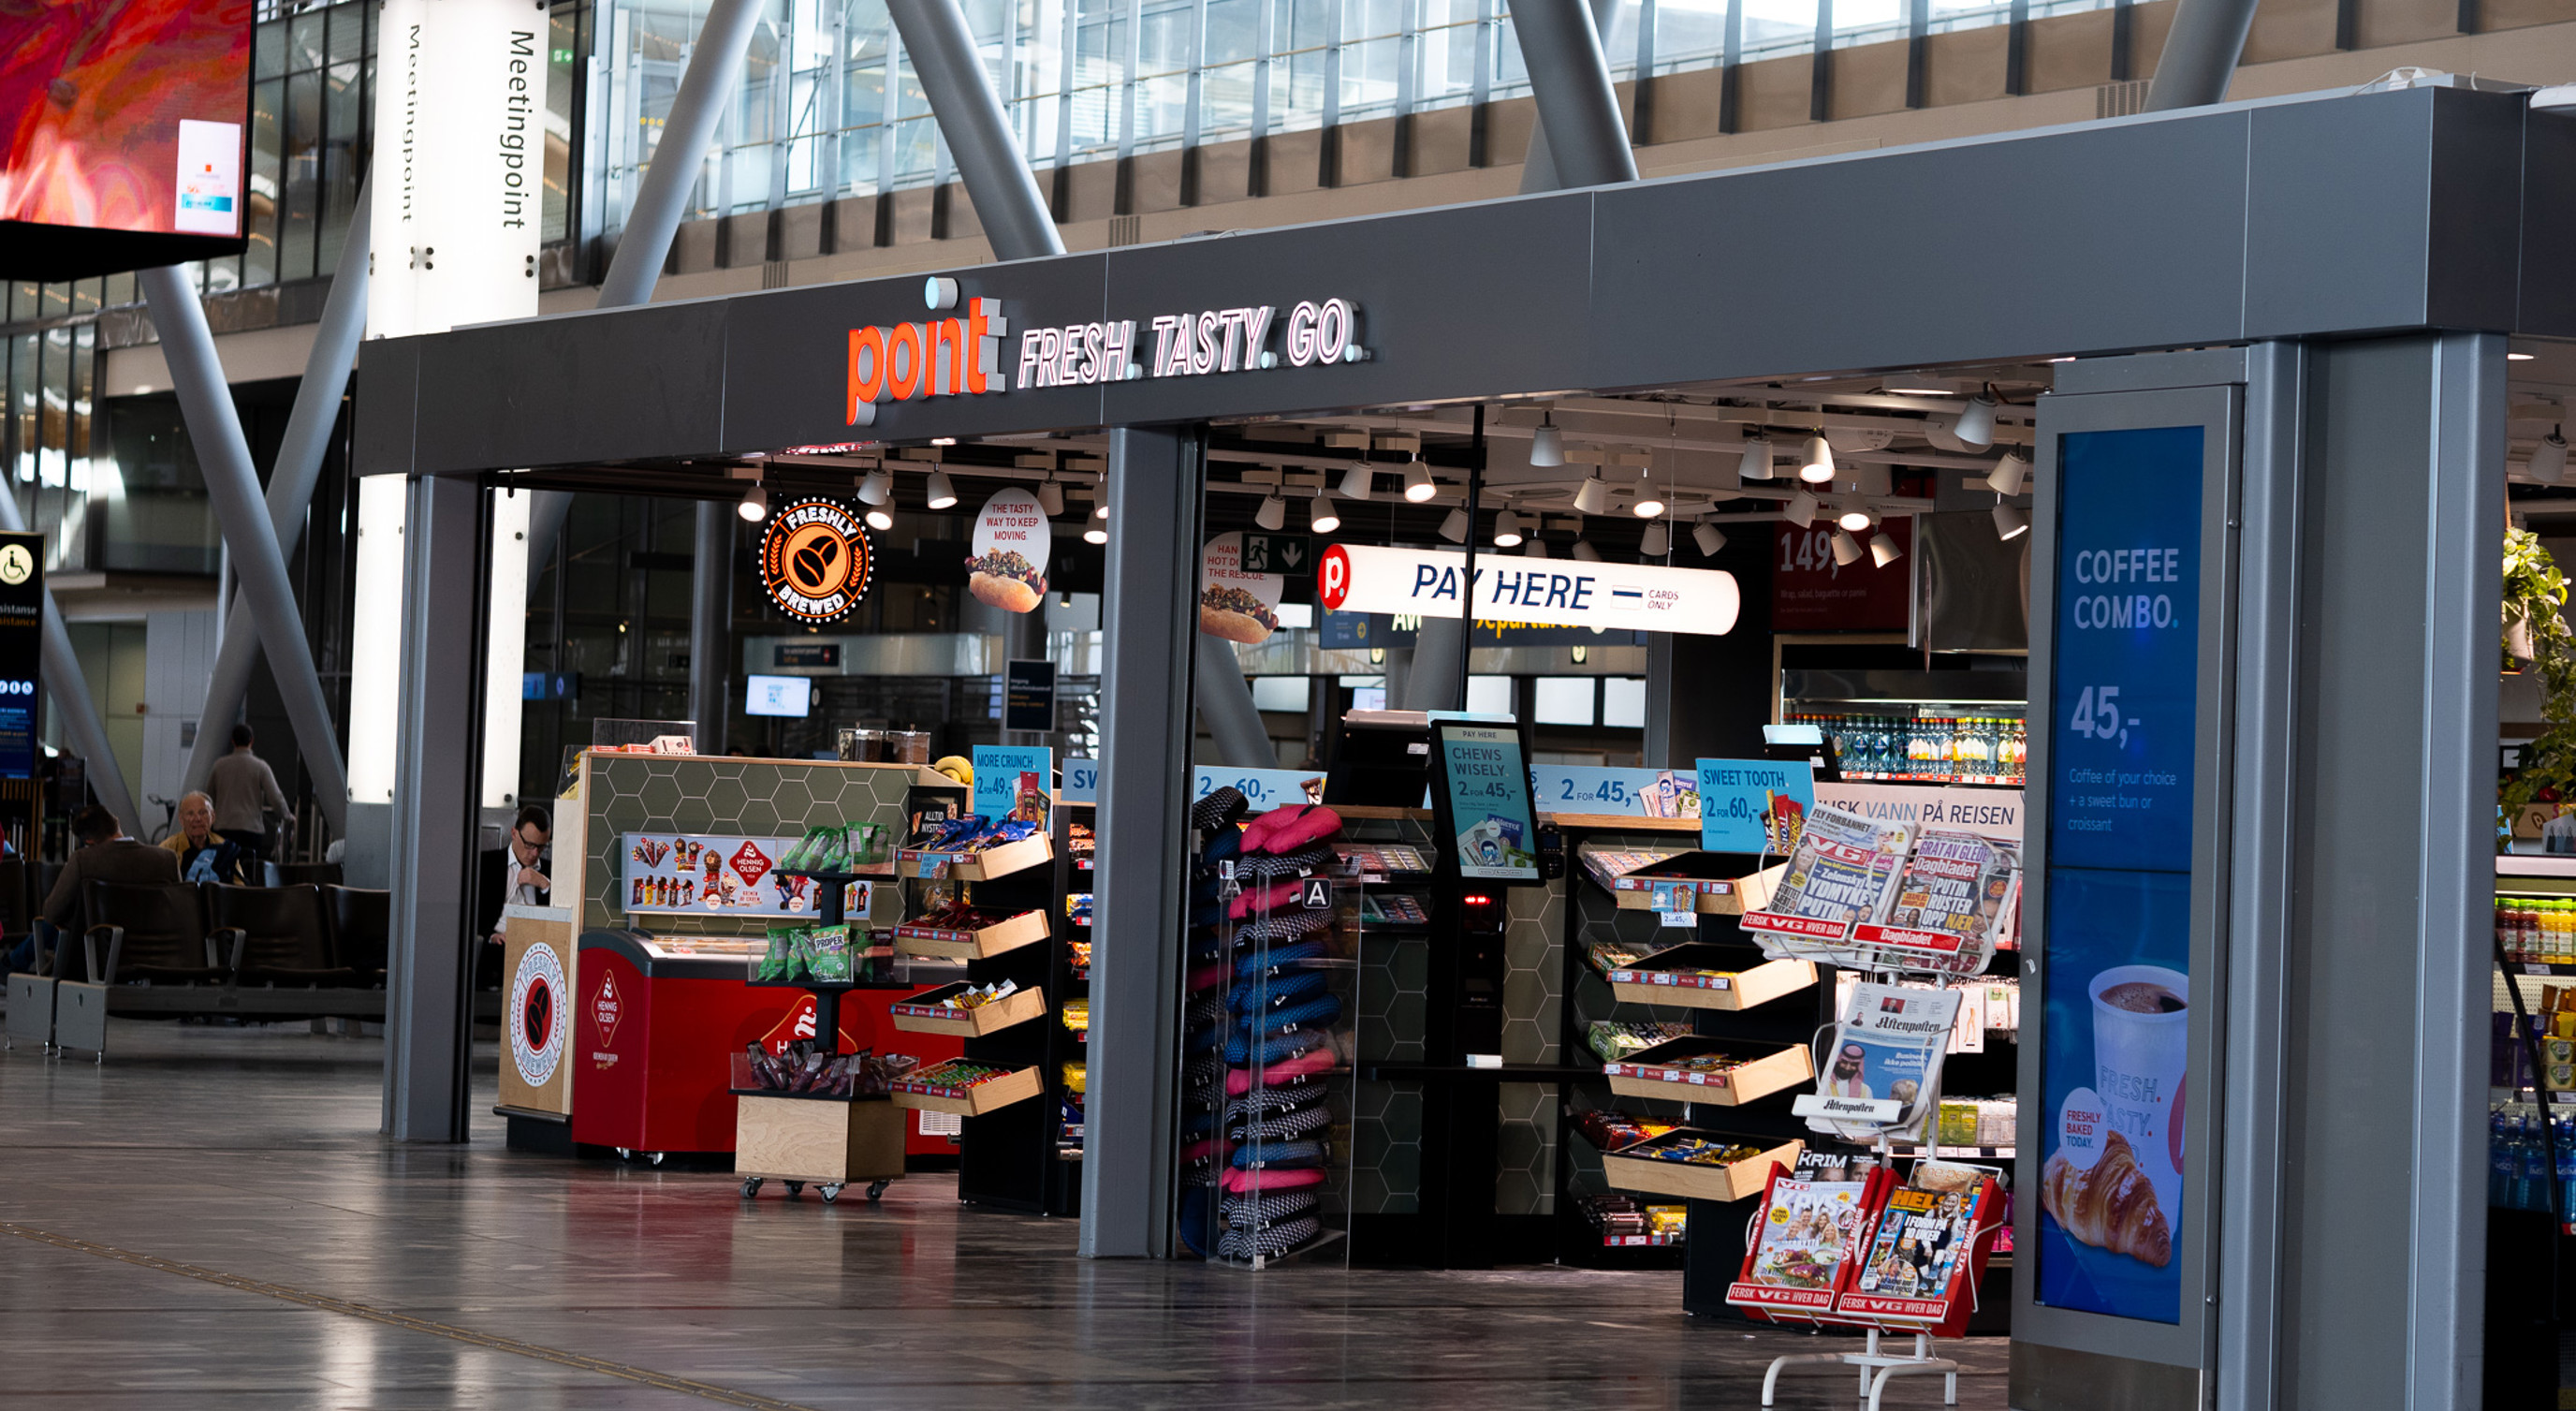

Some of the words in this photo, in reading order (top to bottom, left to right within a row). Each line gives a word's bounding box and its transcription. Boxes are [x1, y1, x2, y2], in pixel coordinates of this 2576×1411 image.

[402, 24, 420, 223] Meetingpoint
[500, 30, 534, 229] Meetingpoint
[846, 276, 998, 426] point
[1017, 319, 1143, 389] FRESH.
[1151, 305, 1277, 377] TASTY.
[1287, 297, 1362, 368] GO.
[992, 504, 1007, 514] THE
[1009, 504, 1034, 514] TASTY
[786, 507, 857, 537] FRESHLY
[986, 517, 1003, 527] WAY
[1006, 517, 1017, 527] TO
[1017, 517, 1038, 527] KEEP
[1208, 556, 1227, 566] HOT
[2075, 548, 2179, 583] COFFEE
[1208, 568, 1226, 579] THE
[1412, 564, 1484, 600] PAY
[1492, 569, 1596, 610] HERE
[1648, 589, 1679, 600] CARDS
[778, 584, 844, 615] BREWED
[1647, 600, 1674, 610] ONLY
[2073, 594, 2179, 629] COMBO.
[2070, 685, 2141, 749] 45,-
[976, 754, 999, 768] MORE
[1453, 747, 1502, 761] CHEWS
[976, 776, 984, 794] 2
[993, 776, 1013, 799] 49,-
[1199, 775, 1212, 795] 2
[1704, 770, 1741, 786] SWEET
[2069, 768, 2102, 786] Coffee
[2104, 769, 2116, 785] of
[2118, 772, 2141, 788] your
[2144, 769, 2176, 786] choice
[1457, 781, 1469, 796] 2
[1485, 782, 1516, 801] 45,-
[1561, 778, 1574, 801] 2
[1577, 793, 1593, 801] FOR
[1595, 780, 1640, 808] 45,-
[1706, 797, 1716, 817] 2
[1717, 809, 1729, 819] FOR
[1730, 797, 1758, 824] 60,-
[2078, 797, 2086, 809] a
[2086, 796, 2116, 810] sweet
[2118, 794, 2138, 810] bun
[2140, 797, 2152, 810] or
[925, 811, 944, 821] ALLTID
[1812, 808, 1826, 819] FLY
[1825, 812, 1872, 833] FORBANNET
[1866, 801, 1917, 822] VANN
[1923, 799, 1944, 824] PÅ
[1950, 804, 2014, 826] REISEN
[2068, 816, 2113, 832] croissant
[1807, 832, 1864, 861] VG
[1958, 845, 1989, 863] GLEDE
[737, 858, 764, 866] HENNIG
[1914, 857, 1978, 878] Dagbladet
[1307, 881, 1326, 905] A
[1933, 877, 1970, 898] PUTIN
[1798, 894, 1849, 920] PUTIN
[1928, 893, 1973, 915] RUSTER
[1742, 914, 1769, 928] FERSK
[1771, 917, 1807, 931] VG
[1805, 921, 1826, 934] HVER
[1826, 924, 1843, 937] DAG
[1922, 909, 1947, 927] OPP
[1944, 913, 1974, 931] NÆR
[815, 935, 843, 949] PROPER
[1881, 928, 1932, 947] Dagbladet
[523, 954, 558, 984] FRESHLY
[596, 1000, 618, 1012] HENNIG
[598, 1012, 616, 1023] OLSEN
[1875, 1016, 1940, 1034] Aftenposten
[521, 1045, 552, 1074] BREWED
[1823, 1098, 1875, 1114] Aftenposten
[2066, 1109, 2101, 1124] FRESHLY
[2066, 1123, 2094, 1136] BAKED
[1798, 1153, 1848, 1168] KRIM
[1778, 1180, 1810, 1192] VG
[1910, 1215, 1937, 1230] FORM
[1904, 1227, 1916, 1238] 10
[1915, 1228, 1941, 1242] UKER
[1731, 1286, 1755, 1300] FERSK
[1758, 1289, 1791, 1301] VG
[1792, 1291, 1812, 1303] HVER
[1812, 1293, 1830, 1305] DAG
[1842, 1297, 1867, 1311] FERSK
[1869, 1300, 1903, 1312] VG
[1904, 1302, 1925, 1315] HVER
[1925, 1303, 1943, 1315] DAG
